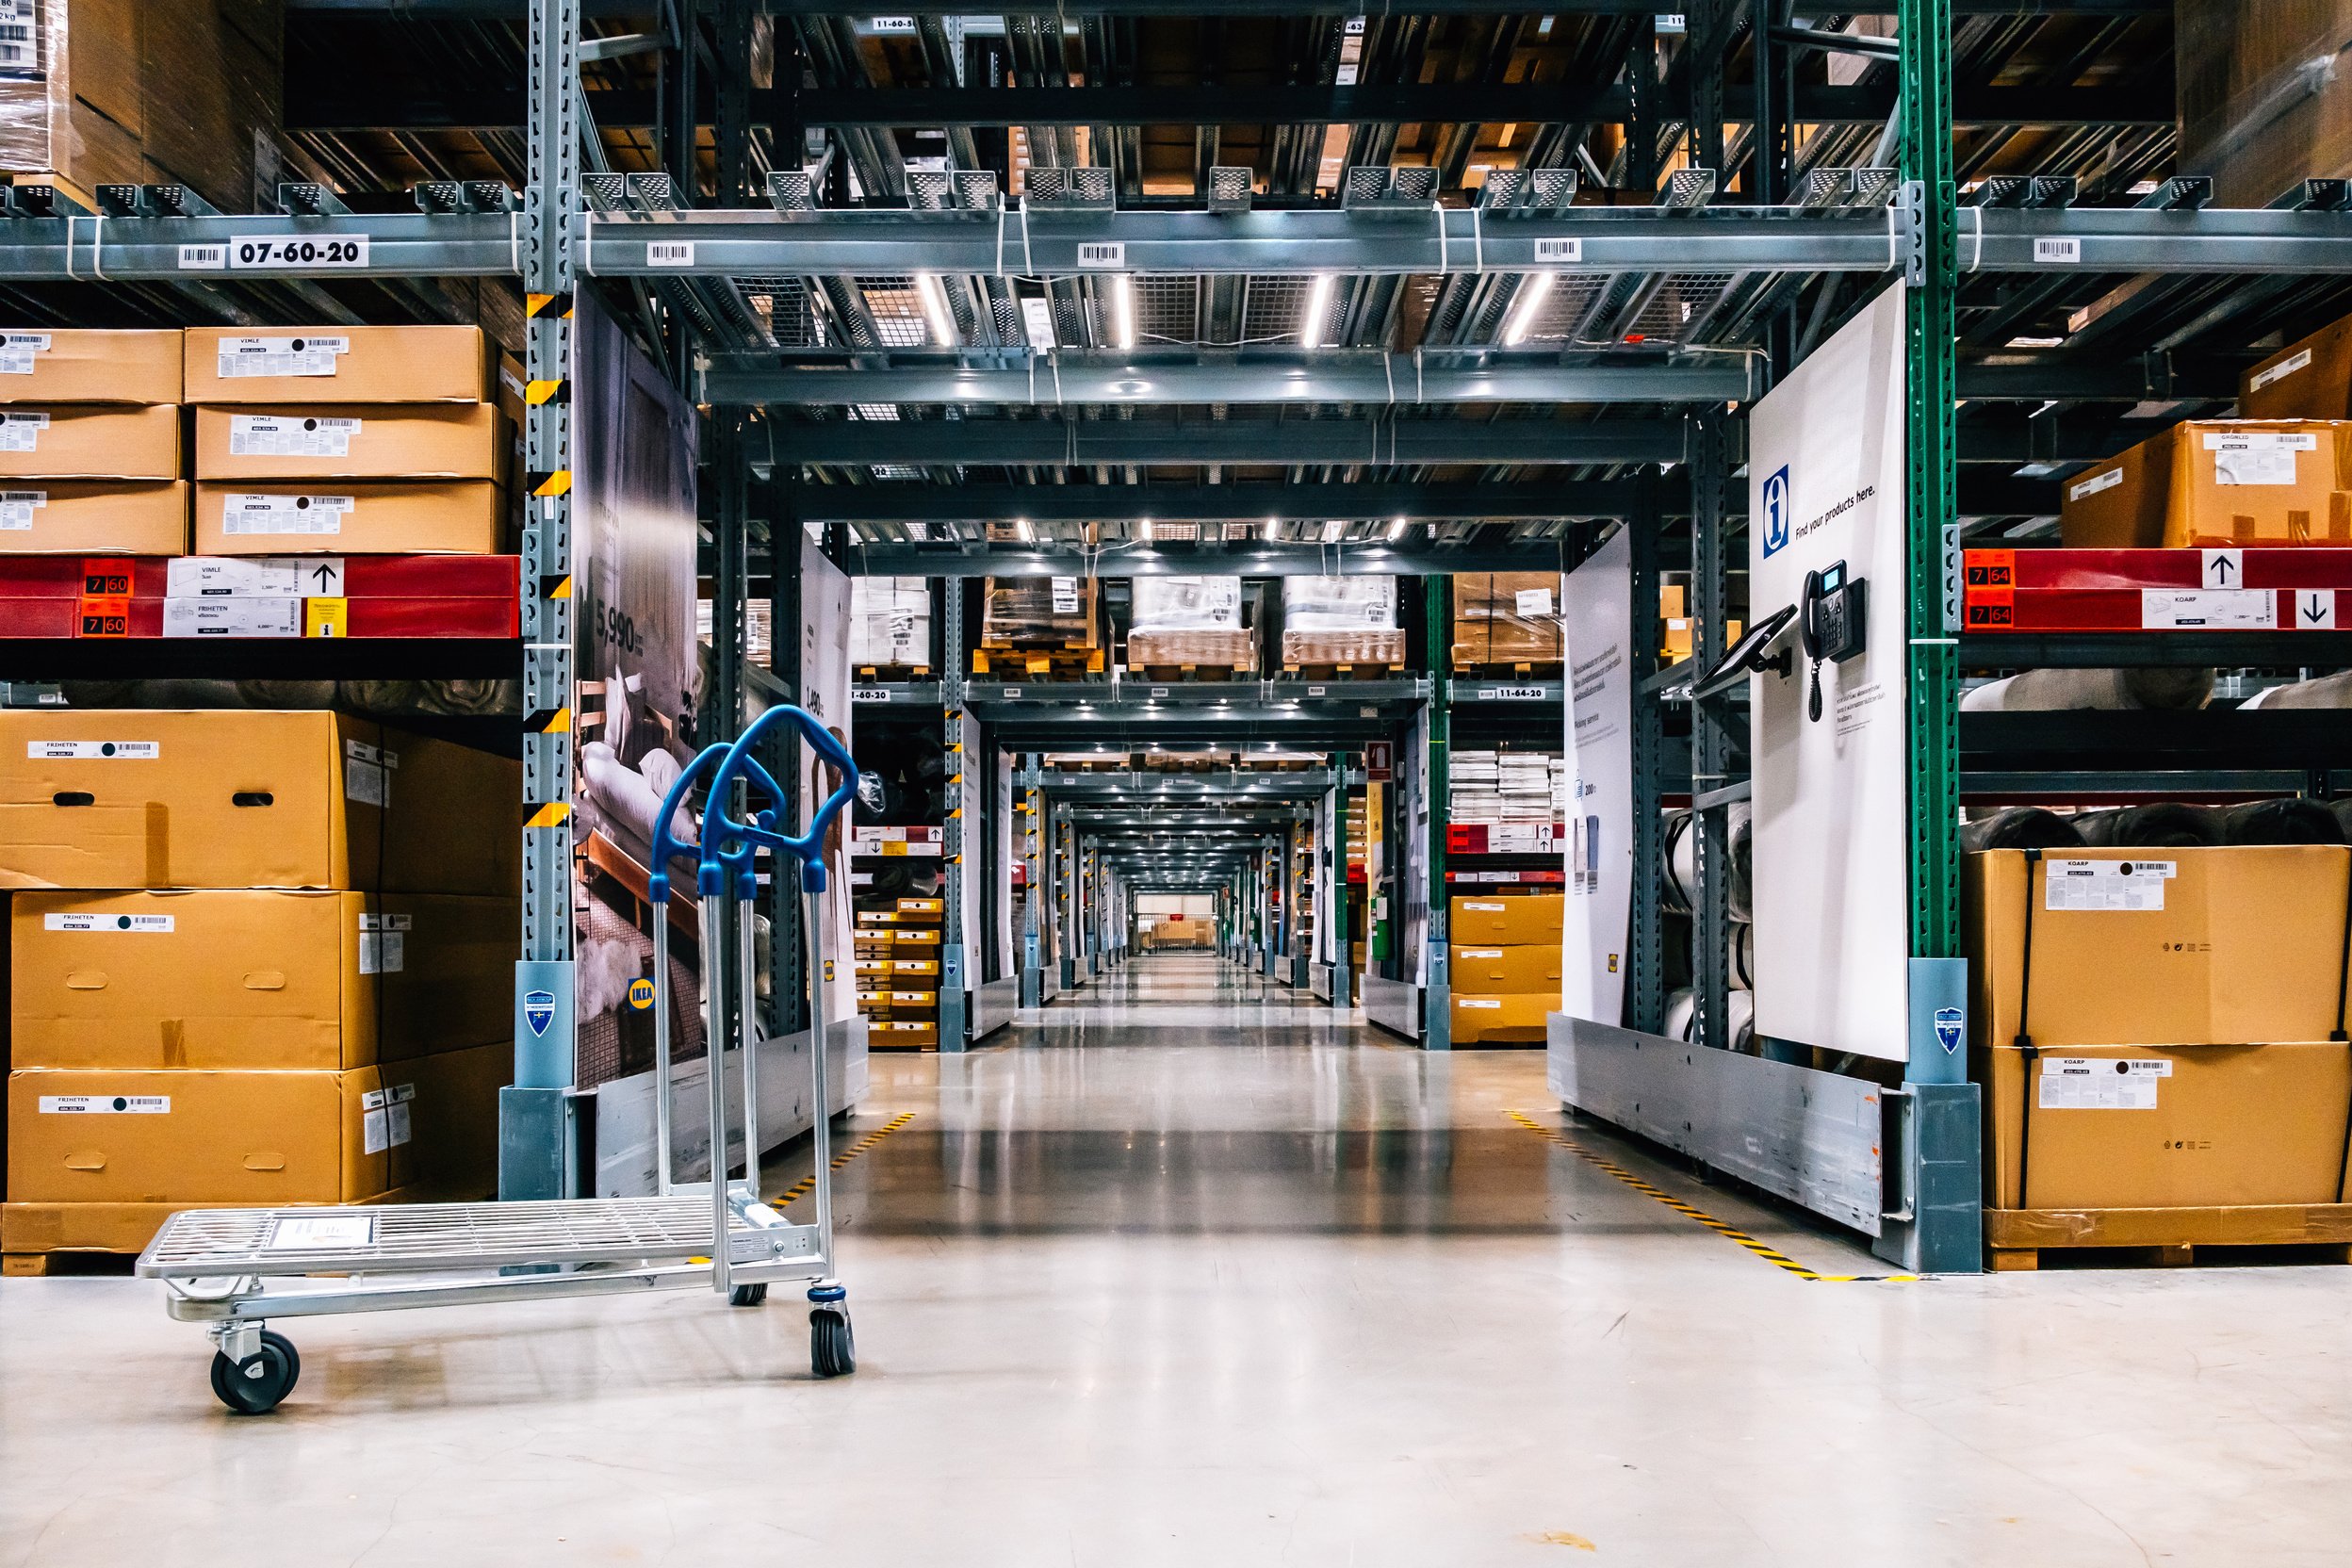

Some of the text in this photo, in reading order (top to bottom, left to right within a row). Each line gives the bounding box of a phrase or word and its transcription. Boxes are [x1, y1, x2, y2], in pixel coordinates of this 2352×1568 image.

[877, 19, 915, 28] 11-60-5
[240, 241, 360, 264] 07-60-20
[1795, 485, 1876, 541] Find your products here.
[1975, 568, 2009, 582] 7 64
[92, 578, 127, 591] 7 60
[1975, 608, 2010, 621] 7 64
[90, 618, 124, 631] 7 60
[596, 599, 635, 652] 5,990
[1500, 689, 1543, 697] 11-64-20
[632, 987, 653, 1002] IKEA
